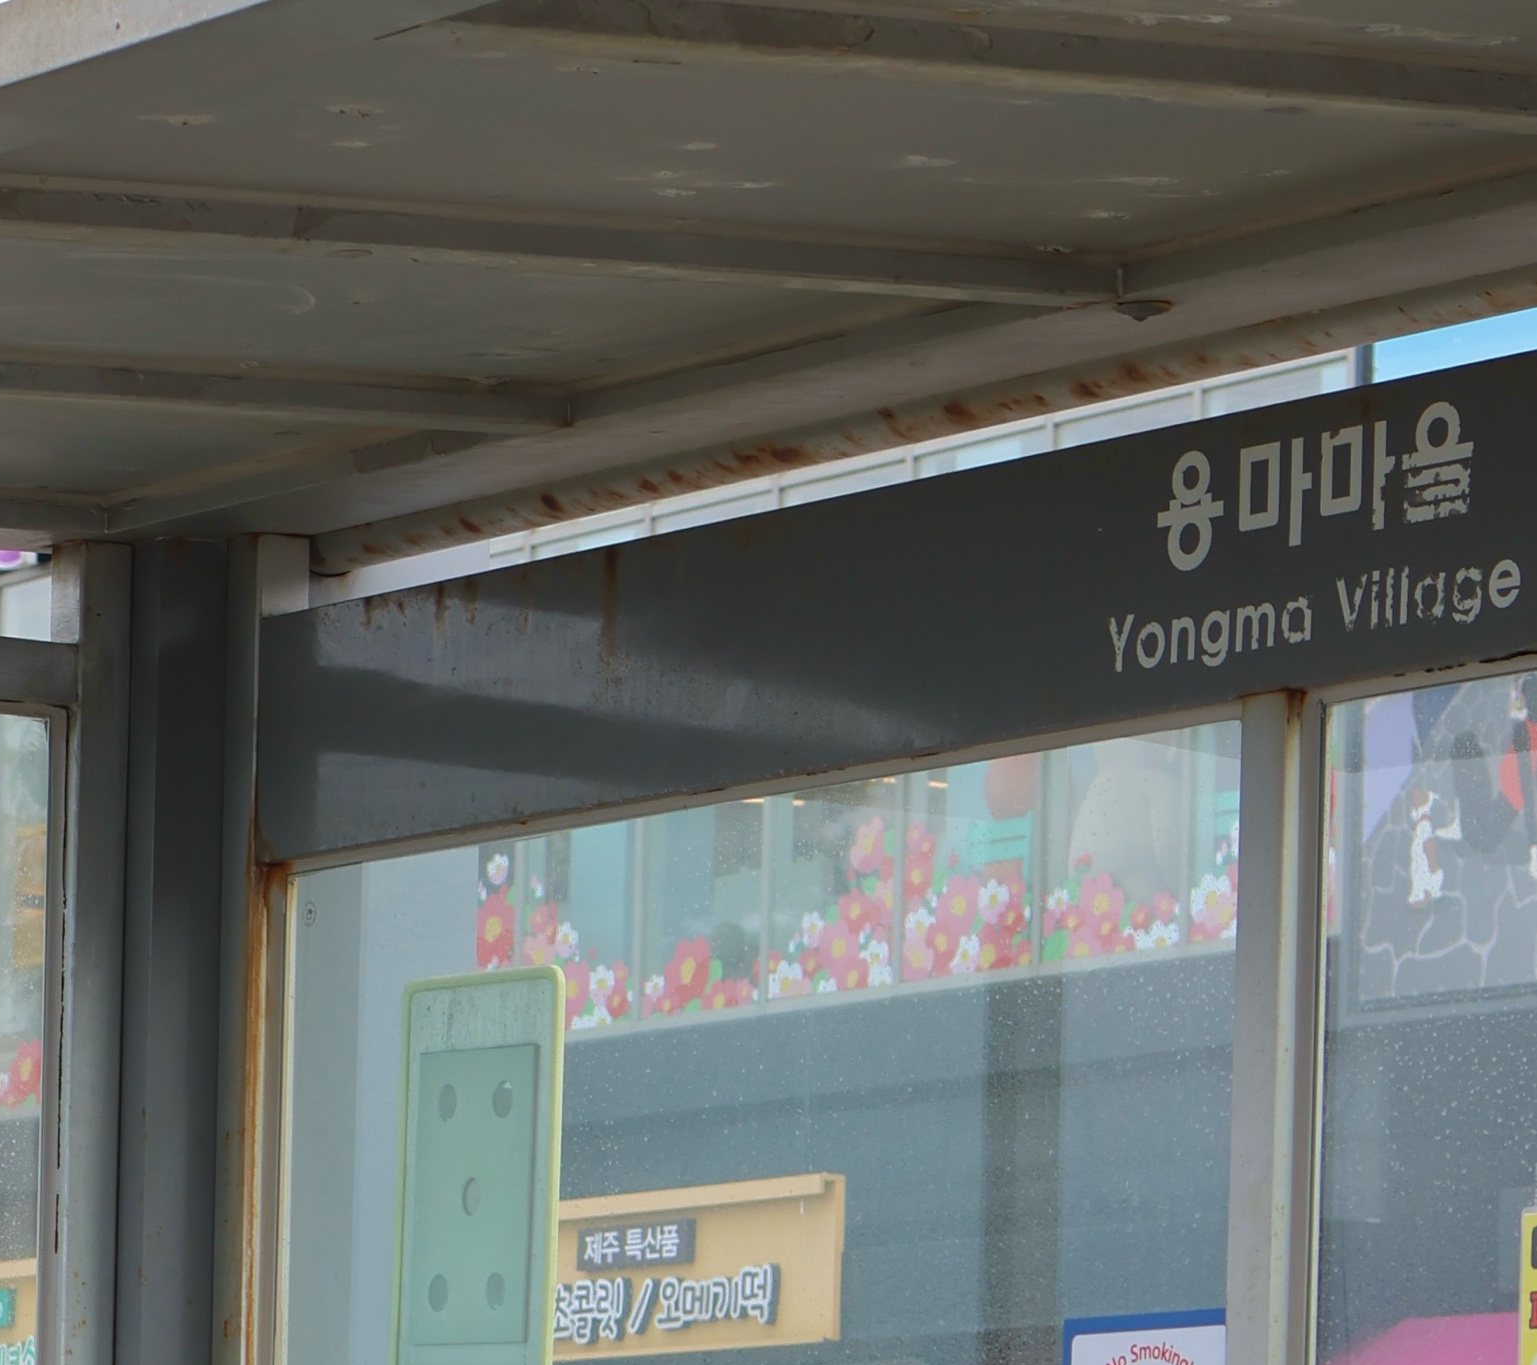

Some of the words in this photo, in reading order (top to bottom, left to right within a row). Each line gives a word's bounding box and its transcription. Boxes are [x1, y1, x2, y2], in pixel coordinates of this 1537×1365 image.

[1156, 401, 1474, 571] 용마마을
[1109, 596, 1314, 673] Yongma
[1336, 559, 1521, 632] Village
[584, 1231, 620, 1265] 제주
[625, 1224, 680, 1262] 특산품
